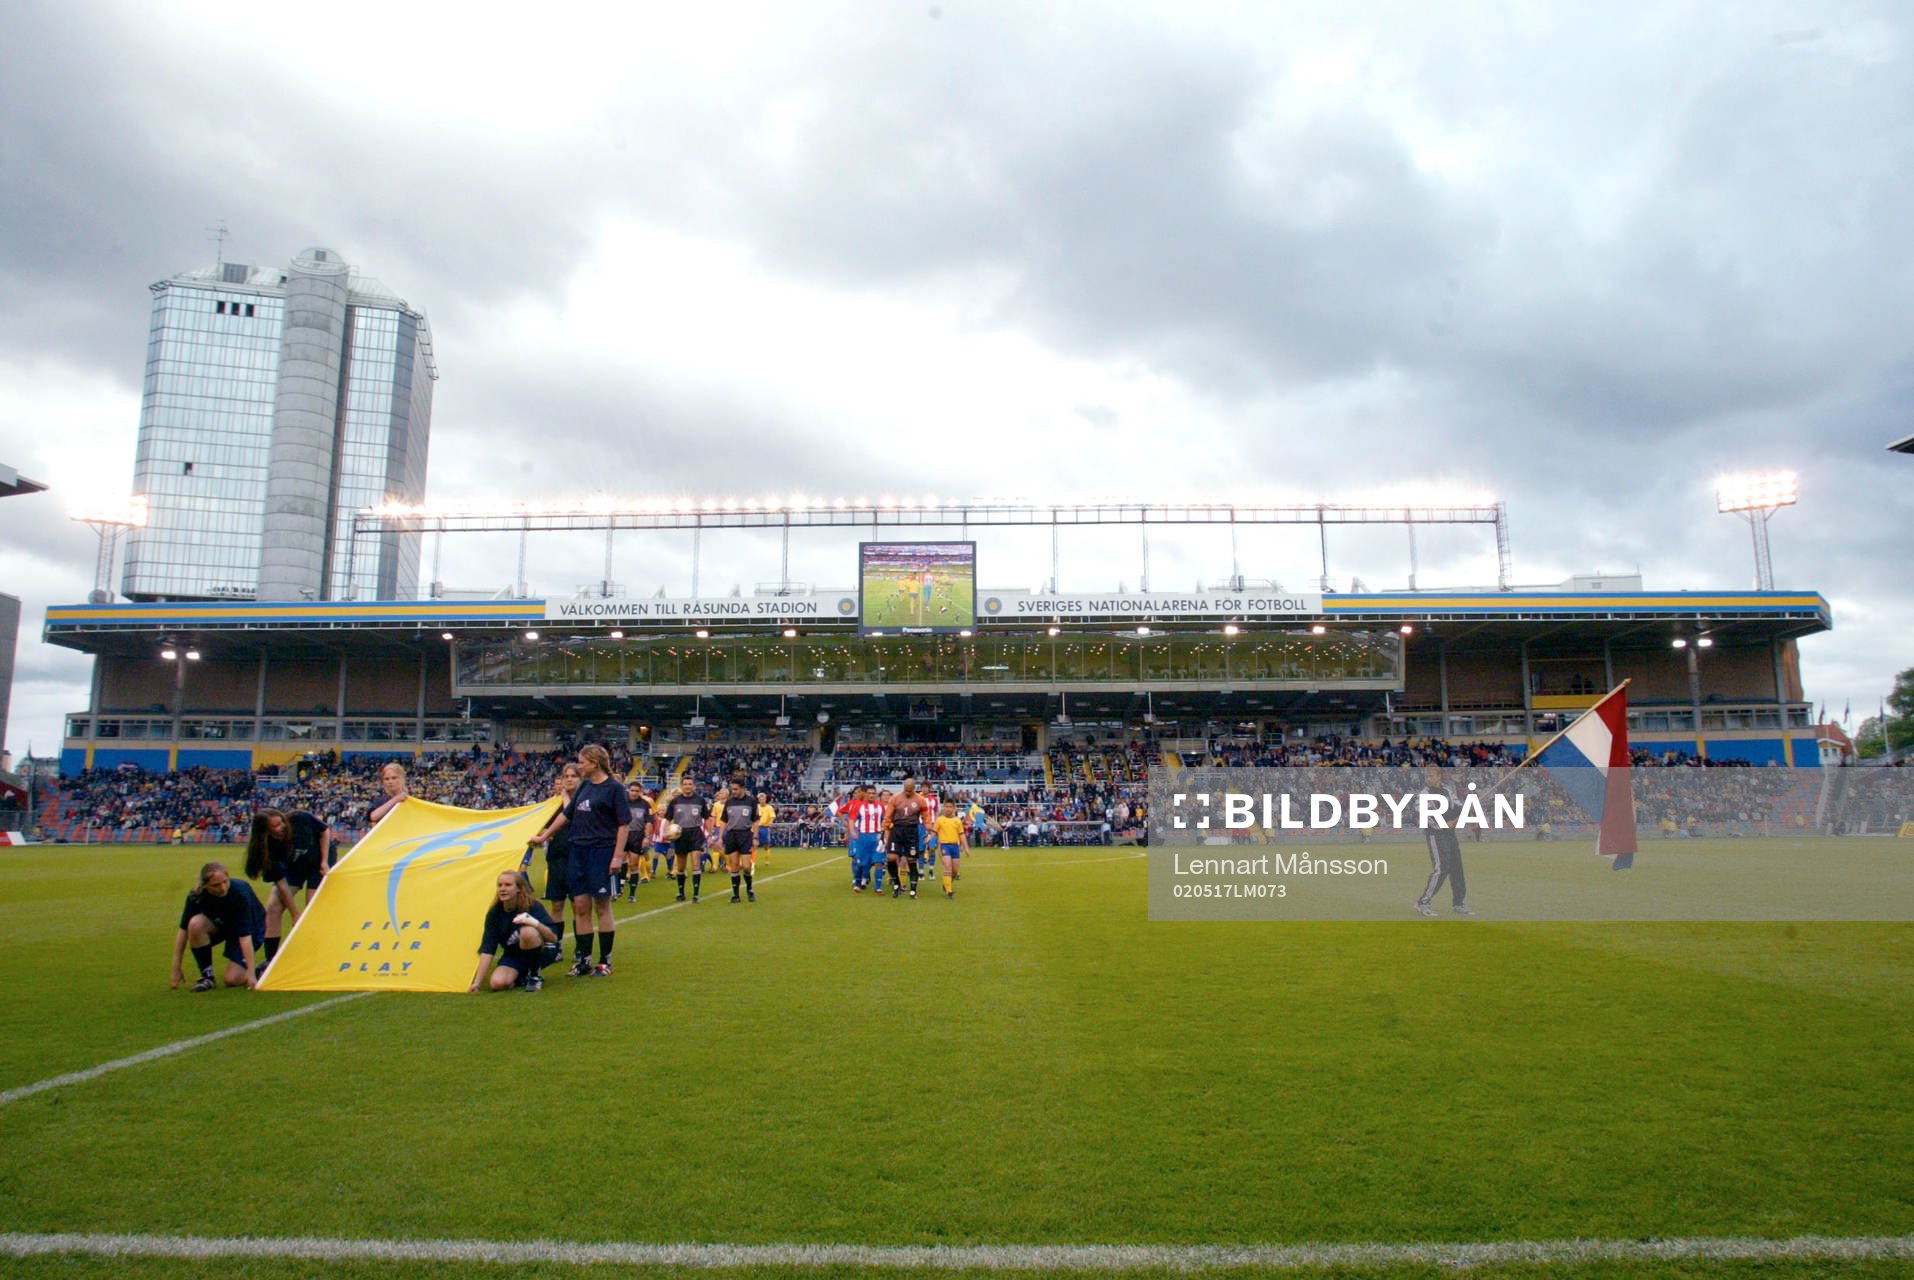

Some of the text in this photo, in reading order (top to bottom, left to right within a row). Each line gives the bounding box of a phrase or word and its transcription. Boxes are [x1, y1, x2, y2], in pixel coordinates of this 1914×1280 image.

[560, 601, 817, 616] VÄLKOMMEN TILL RÅSUNDA STADION
[1018, 597, 1308, 612] SVERIGES NATIONALARENA FÖR FOTBOLL
[361, 921, 431, 930] FIFA
[350, 941, 422, 950] FAIR
[338, 961, 413, 972] PLAY
